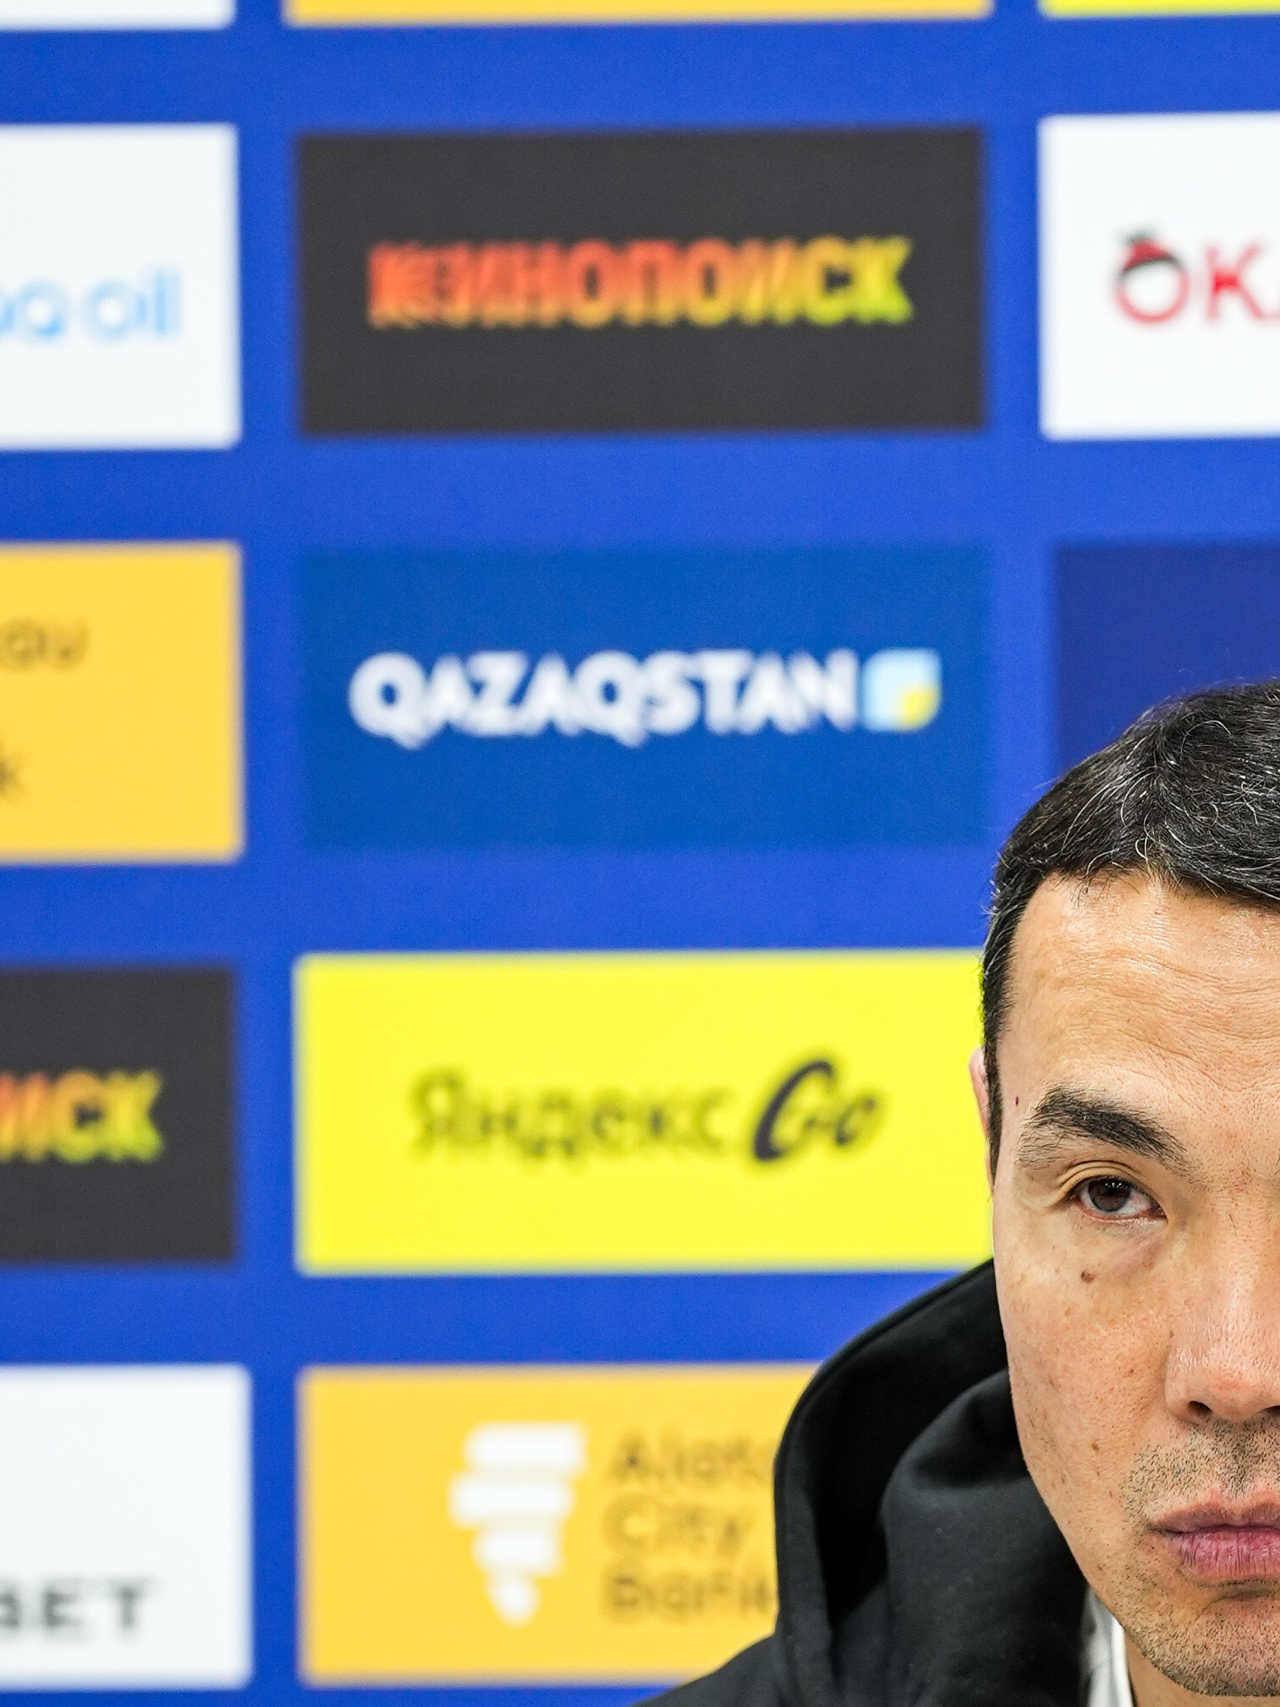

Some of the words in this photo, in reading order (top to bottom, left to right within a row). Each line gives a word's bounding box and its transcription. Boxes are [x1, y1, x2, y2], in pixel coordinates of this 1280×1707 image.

[83, 266, 182, 344] oil
[349, 651, 858, 748] QAZAQSTAN
[406, 1063, 736, 1172] Яндекс
[747, 1053, 883, 1170] Go
